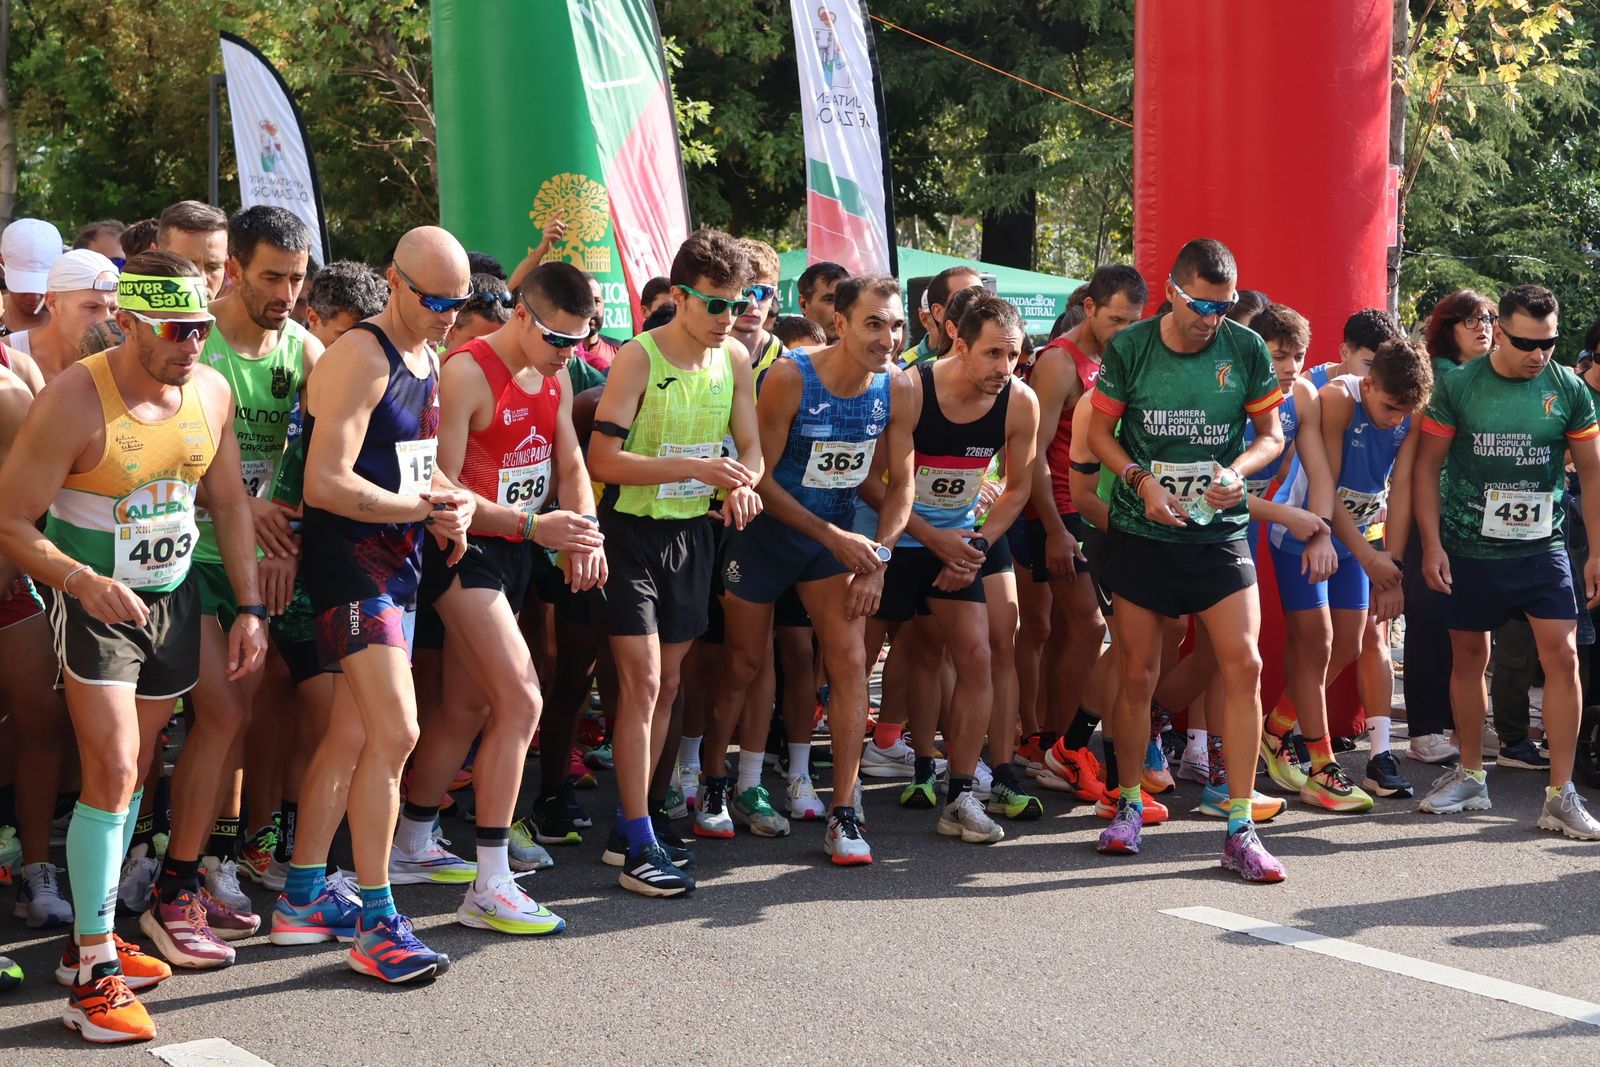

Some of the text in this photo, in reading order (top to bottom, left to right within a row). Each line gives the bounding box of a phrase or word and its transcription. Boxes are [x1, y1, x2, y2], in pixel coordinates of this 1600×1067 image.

[600, 282, 630, 305] ION
[602, 307, 631, 329] RAL
[1025, 307, 1056, 317] RURAL
[1142, 409, 1206, 425] XIII CARRERA
[1143, 424, 1199, 436] GUARDIA
[1189, 434, 1229, 446] ZAMORA
[1472, 432, 1495, 447] XIII
[964, 446, 995, 458] 226ERS
[1473, 446, 1524, 457] GUARDIA
[817, 452, 866, 472] 363
[506, 475, 546, 505] 638
[931, 477, 966, 495] 68
[1159, 474, 1212, 497] 673
[1483, 481, 1541, 490] FUNDACON
[1494, 502, 1542, 523] 431
[128, 532, 193, 566] 403
[146, 561, 177, 571] BOMBERO
